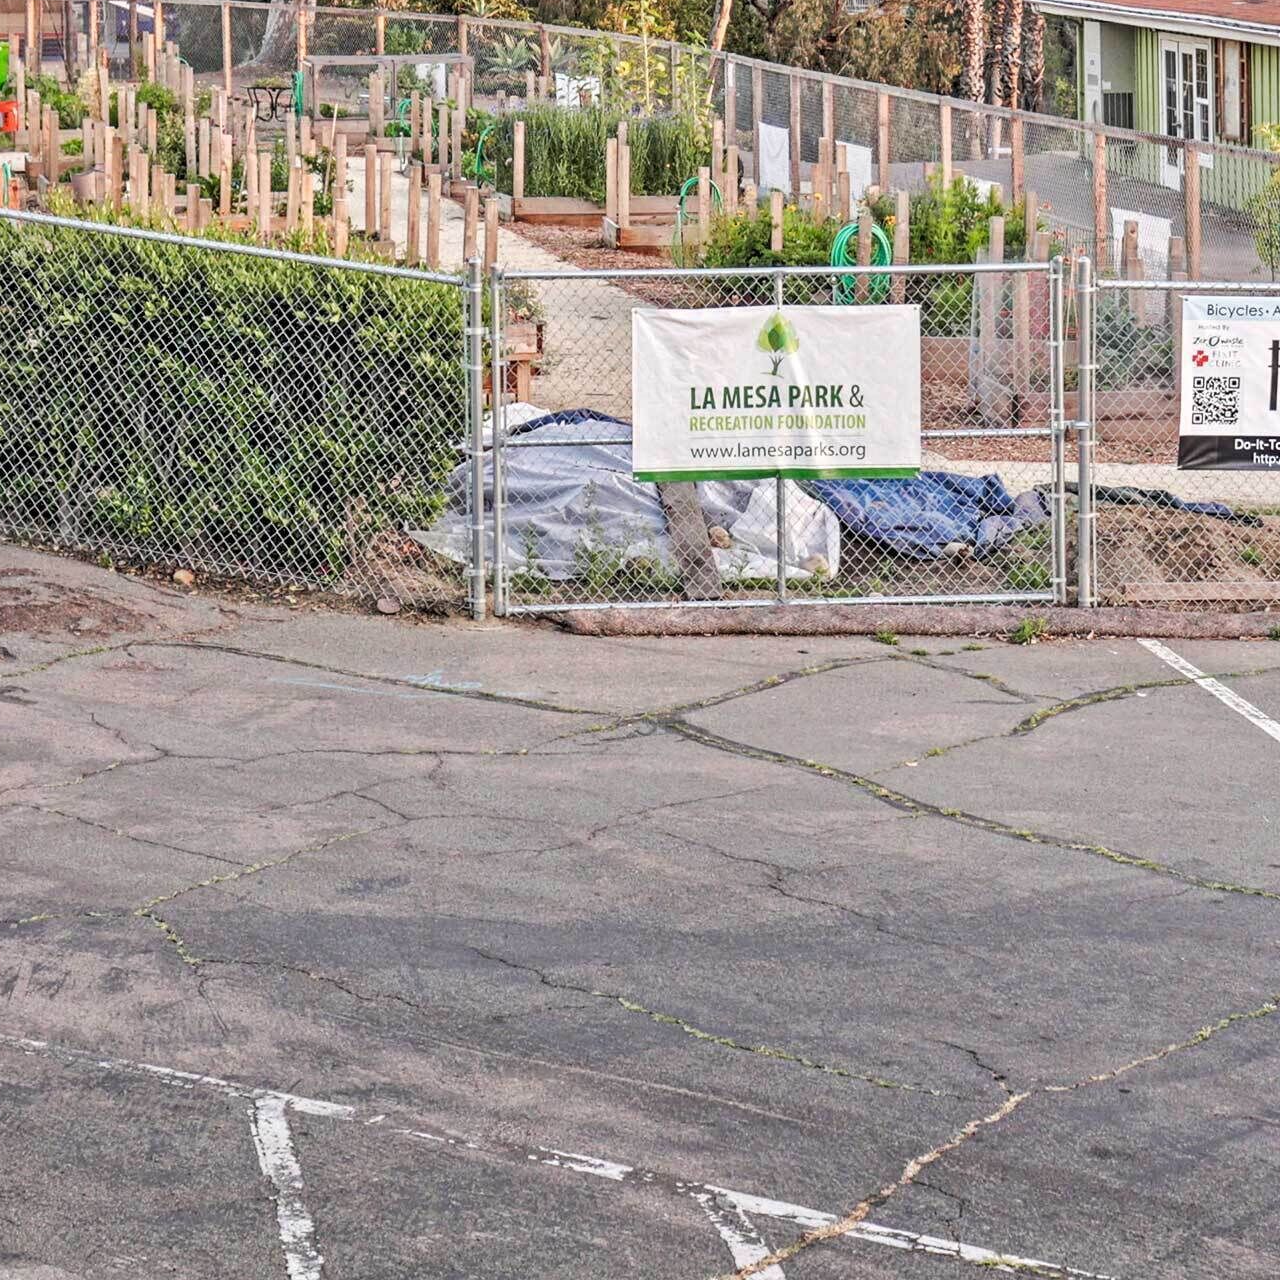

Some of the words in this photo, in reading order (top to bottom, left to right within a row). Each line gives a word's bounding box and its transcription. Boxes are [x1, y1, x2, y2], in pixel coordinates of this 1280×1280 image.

[1207, 304, 1263, 318] Bicycles
[691, 386, 715, 409] LA
[723, 385, 781, 409] MESA
[789, 385, 843, 408] PARK
[850, 385, 863, 407] &
[690, 416, 773, 431] RECREATION
[778, 414, 865, 429] FOUNDATION
[691, 443, 865, 460] www.lamesaparks.org
